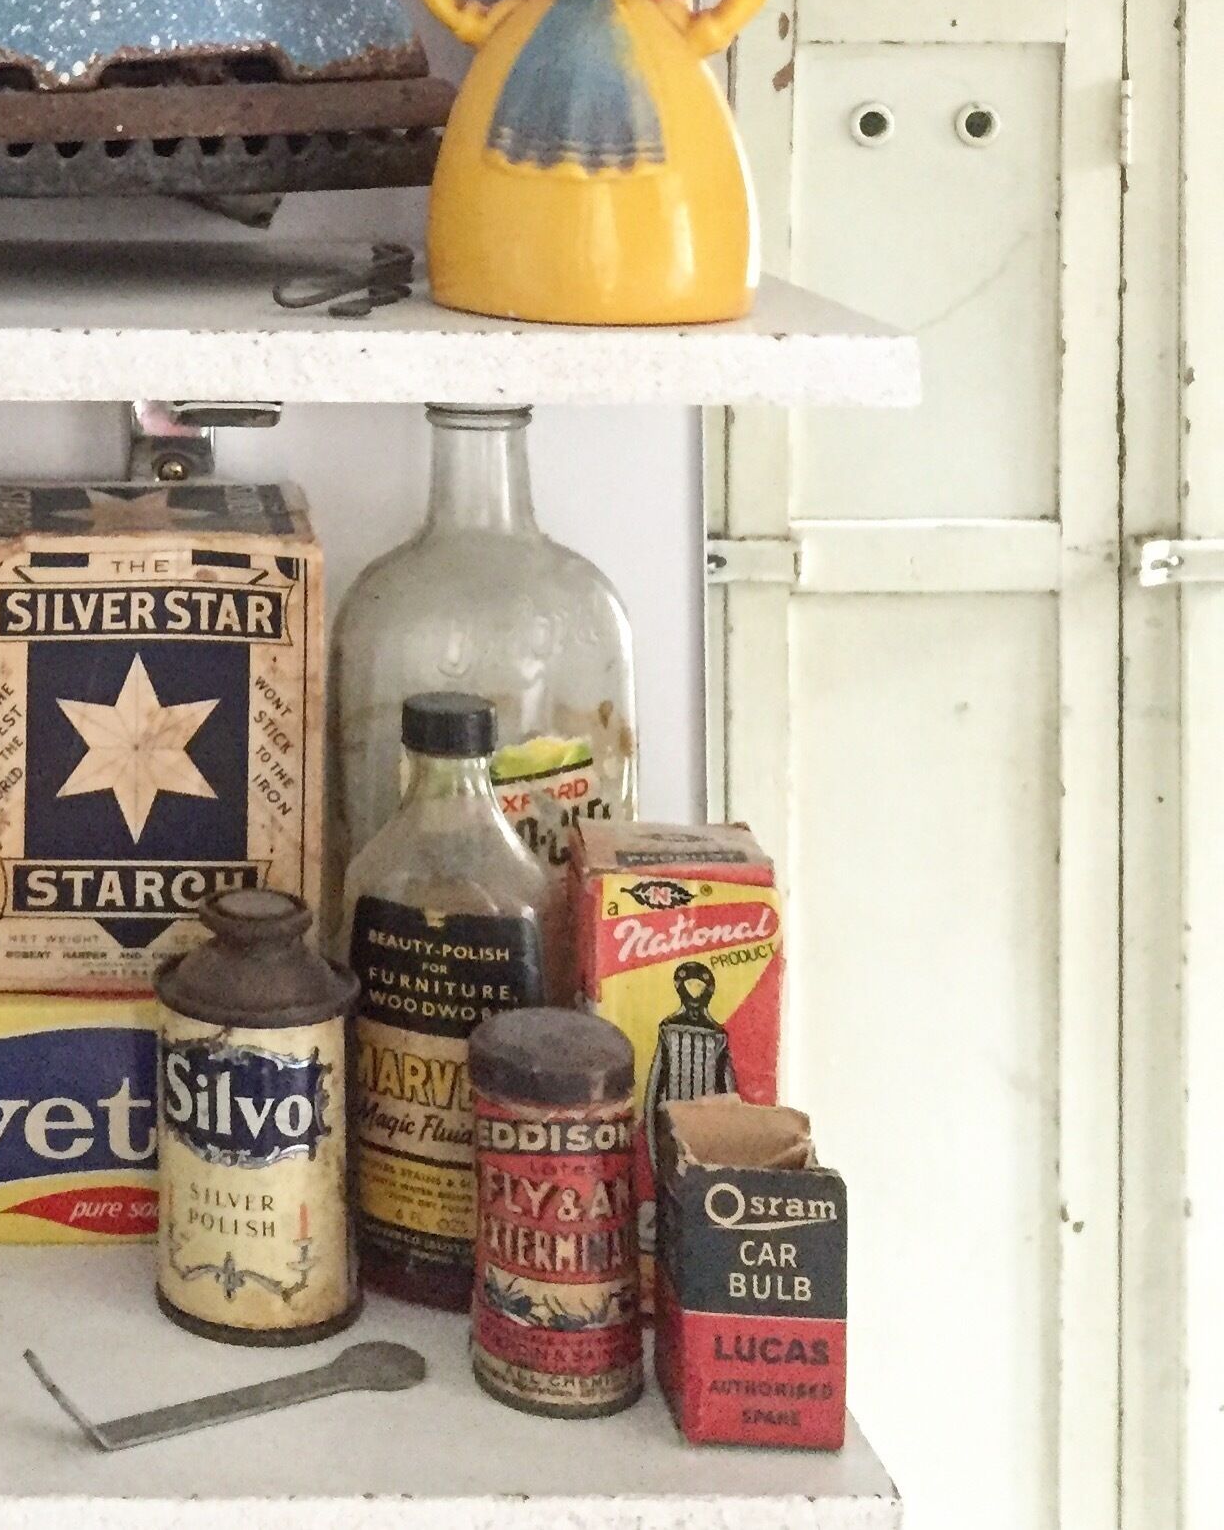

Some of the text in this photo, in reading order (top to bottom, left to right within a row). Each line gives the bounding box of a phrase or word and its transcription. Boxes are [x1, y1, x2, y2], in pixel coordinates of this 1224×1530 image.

[110, 559, 170, 576] THE
[5, 591, 274, 634] SILVER STAR
[254, 675, 293, 717] WONT
[254, 709, 294, 755] STICK
[255, 744, 295, 790] TO THE
[252, 773, 293, 817] IRON
[367, 928, 510, 961] BEAUTY-POLISH
[607, 901, 772, 962] a National
[421, 961, 447, 974] FOR
[710, 942, 775, 970] PRODUCT
[369, 989, 511, 1021] WOODWOR
[166, 1052, 313, 1140] Silvo
[68, 1201, 123, 1223] pure
[190, 1182, 275, 1212] SILVER
[557, 1188, 582, 1222] &
[704, 1183, 838, 1230] Osram
[188, 1206, 276, 1238] POLISH
[739, 1240, 798, 1268] CAR
[728, 1272, 813, 1302] BULB
[713, 1333, 830, 1366] LUCAS
[708, 1379, 833, 1400] AUTHORISED
[741, 1408, 802, 1427] SPARE
